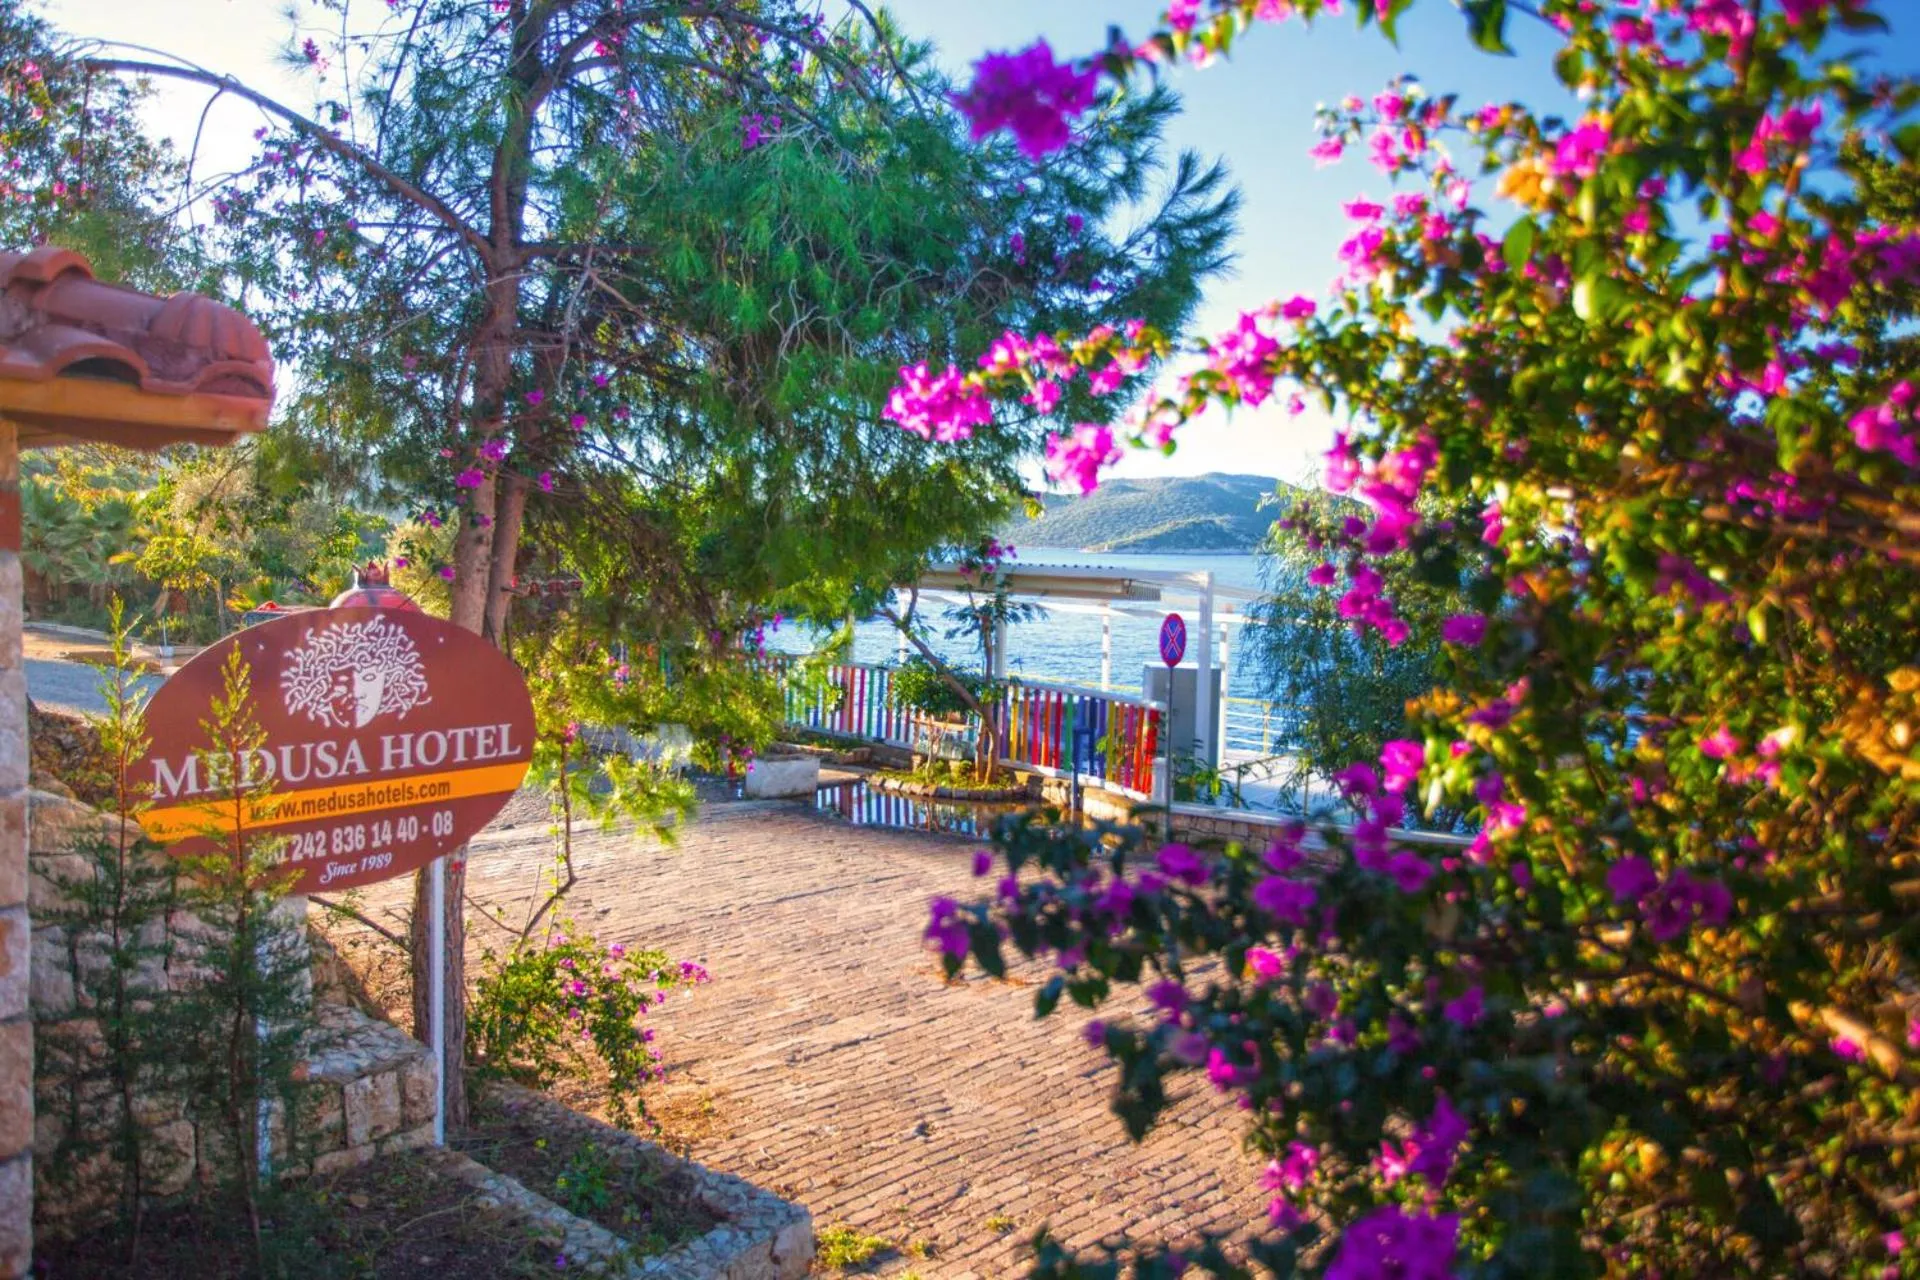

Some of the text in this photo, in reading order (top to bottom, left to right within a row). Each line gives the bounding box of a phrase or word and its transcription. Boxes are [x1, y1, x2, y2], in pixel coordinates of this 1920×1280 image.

[151, 723, 522, 799] MEDUSA HOTEL
[292, 830, 327, 862] 242
[332, 823, 366, 854] 836
[371, 819, 392, 848] 14
[397, 815, 418, 843] 40
[433, 810, 454, 837] 08
[319, 852, 393, 884] Since 1989
